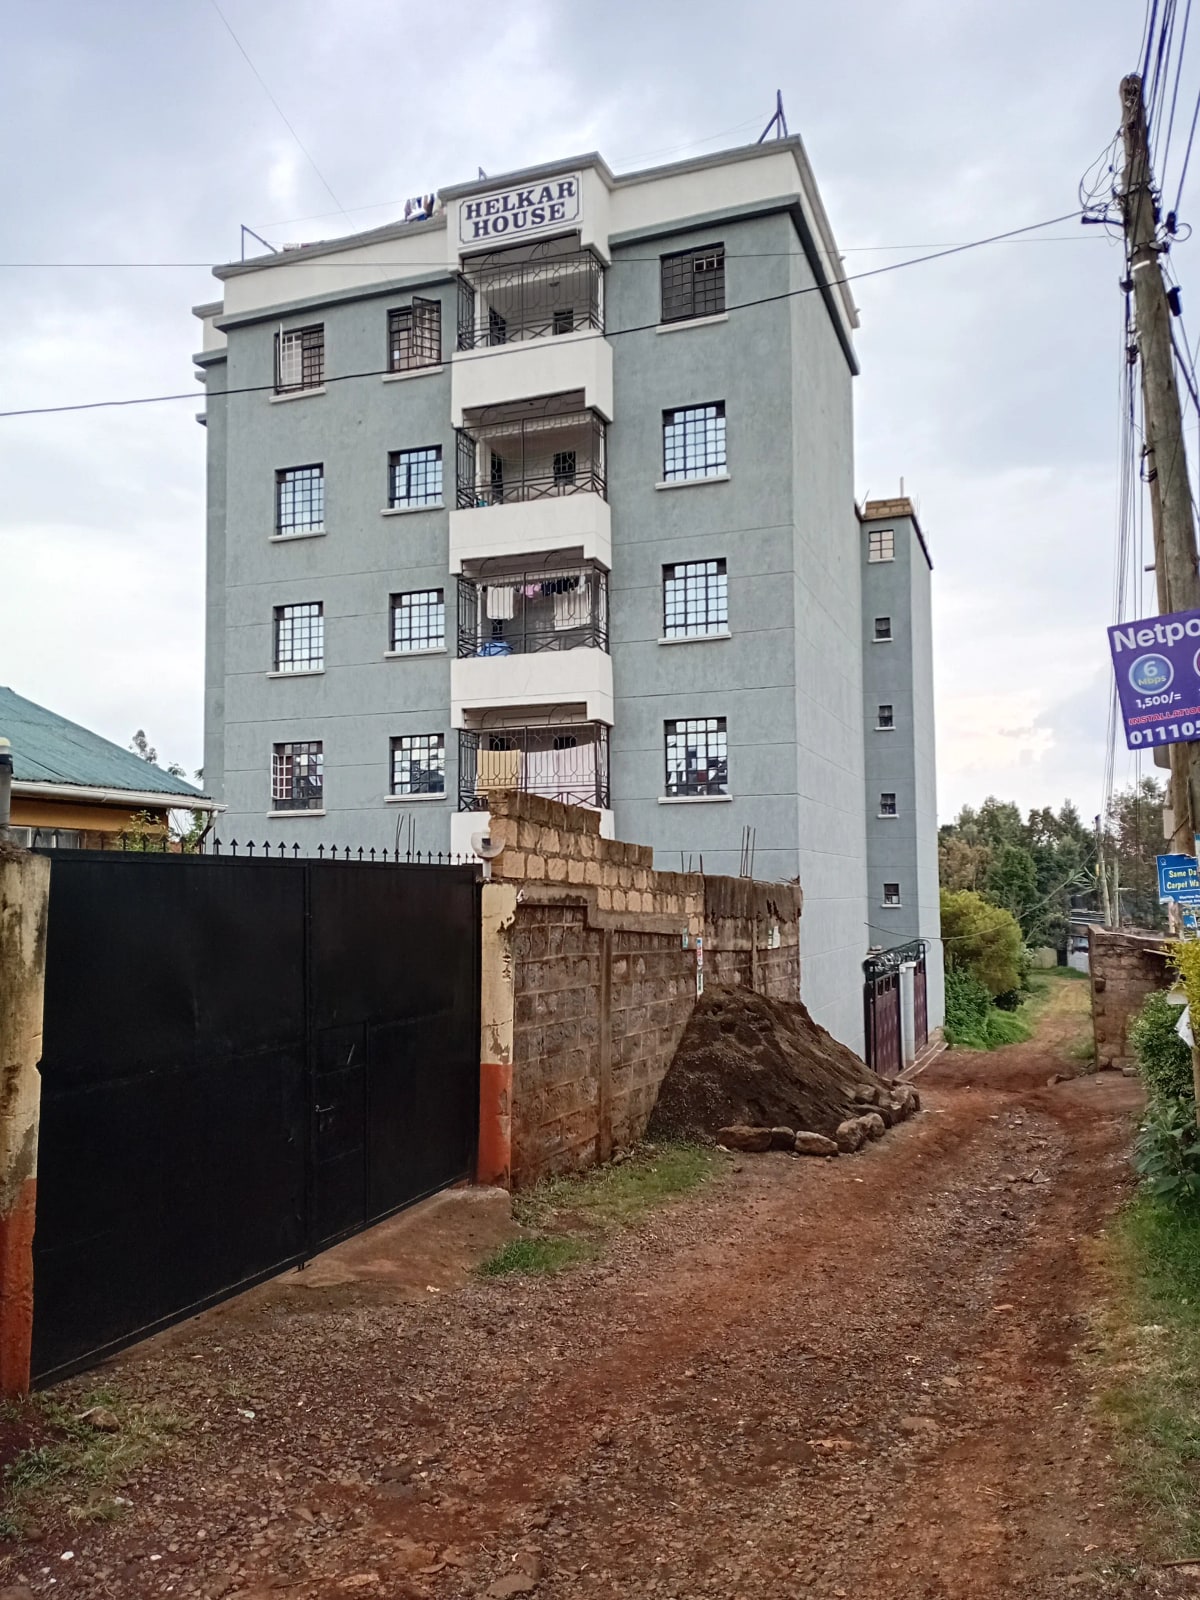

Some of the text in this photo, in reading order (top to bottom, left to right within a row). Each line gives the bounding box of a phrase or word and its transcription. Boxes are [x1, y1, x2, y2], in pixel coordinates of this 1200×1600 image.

[465, 181, 576, 220] HELKAR
[472, 202, 566, 238] HOUSE
[1143, 660, 1158, 677] 6
[1138, 675, 1167, 686] Mbps
[1135, 691, 1182, 709] 1,500/=
[1169, 870, 1187, 878] Same
[1166, 881, 1188, 890] Carpet
